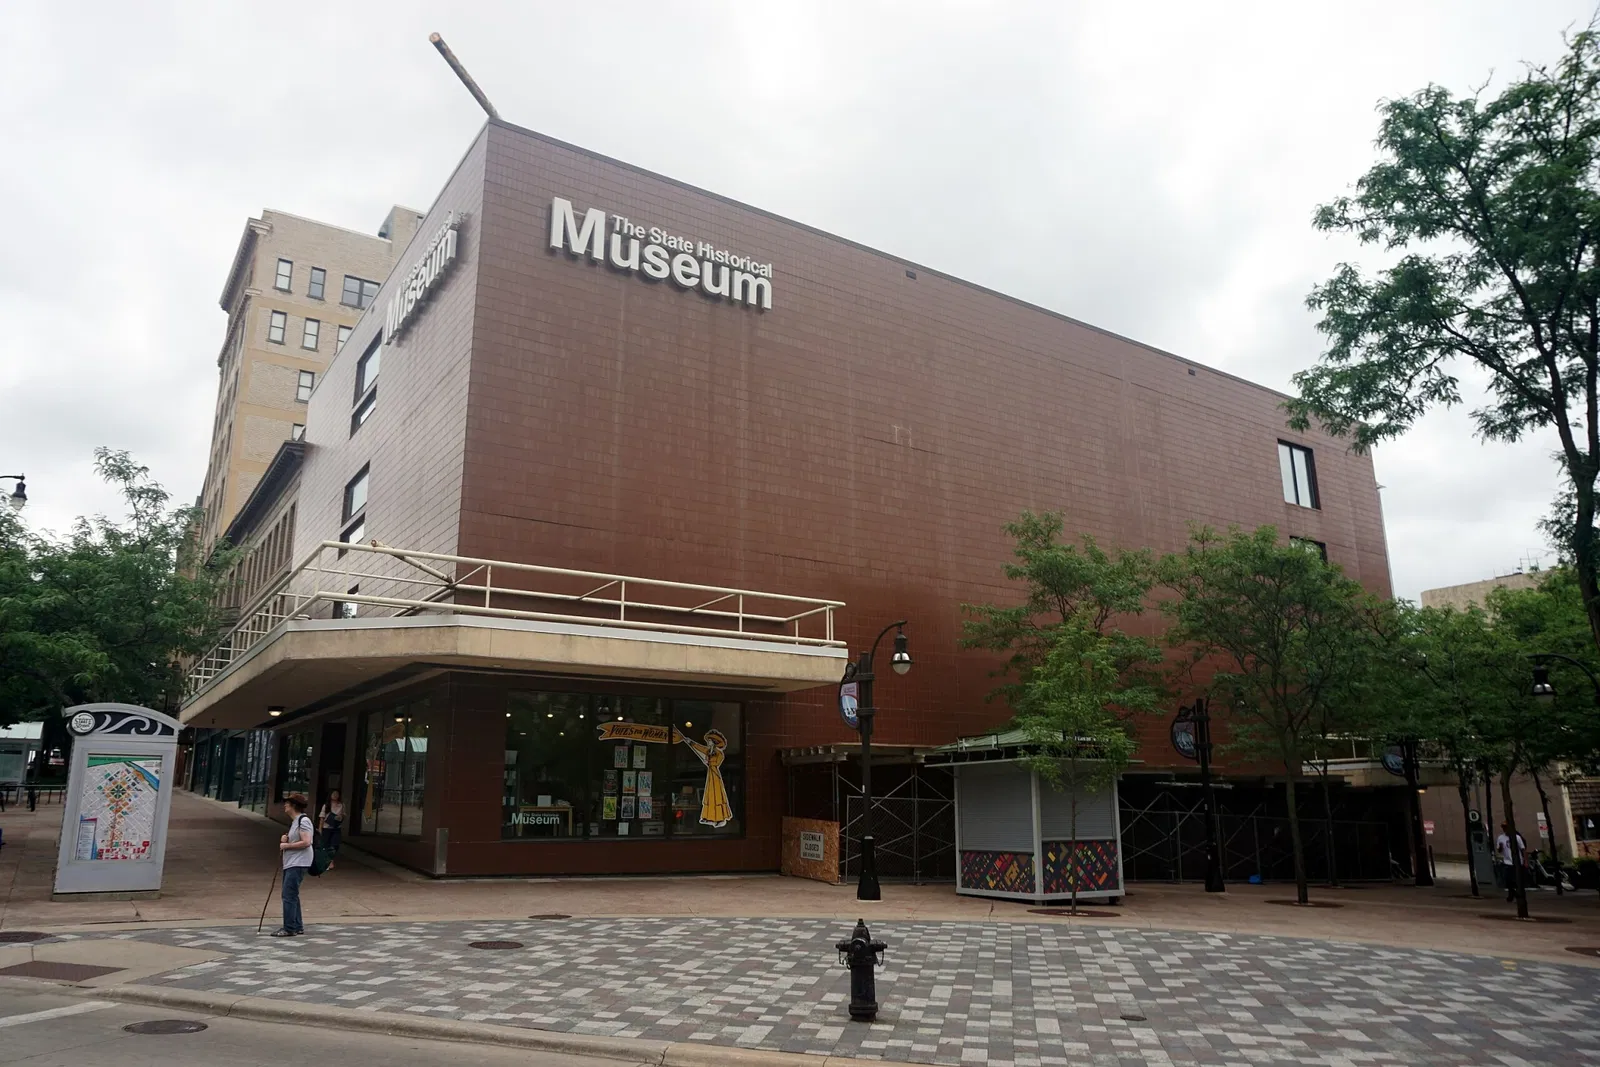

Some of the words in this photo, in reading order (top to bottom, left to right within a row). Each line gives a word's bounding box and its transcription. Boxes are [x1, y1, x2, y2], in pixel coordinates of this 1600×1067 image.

[550, 196, 773, 310] Museum
[611, 214, 646, 239] The
[649, 226, 694, 254] State
[696, 241, 773, 279] Historical
[384, 228, 458, 346] Museum
[609, 724, 635, 738] VOTES
[511, 812, 560, 825] Museum
